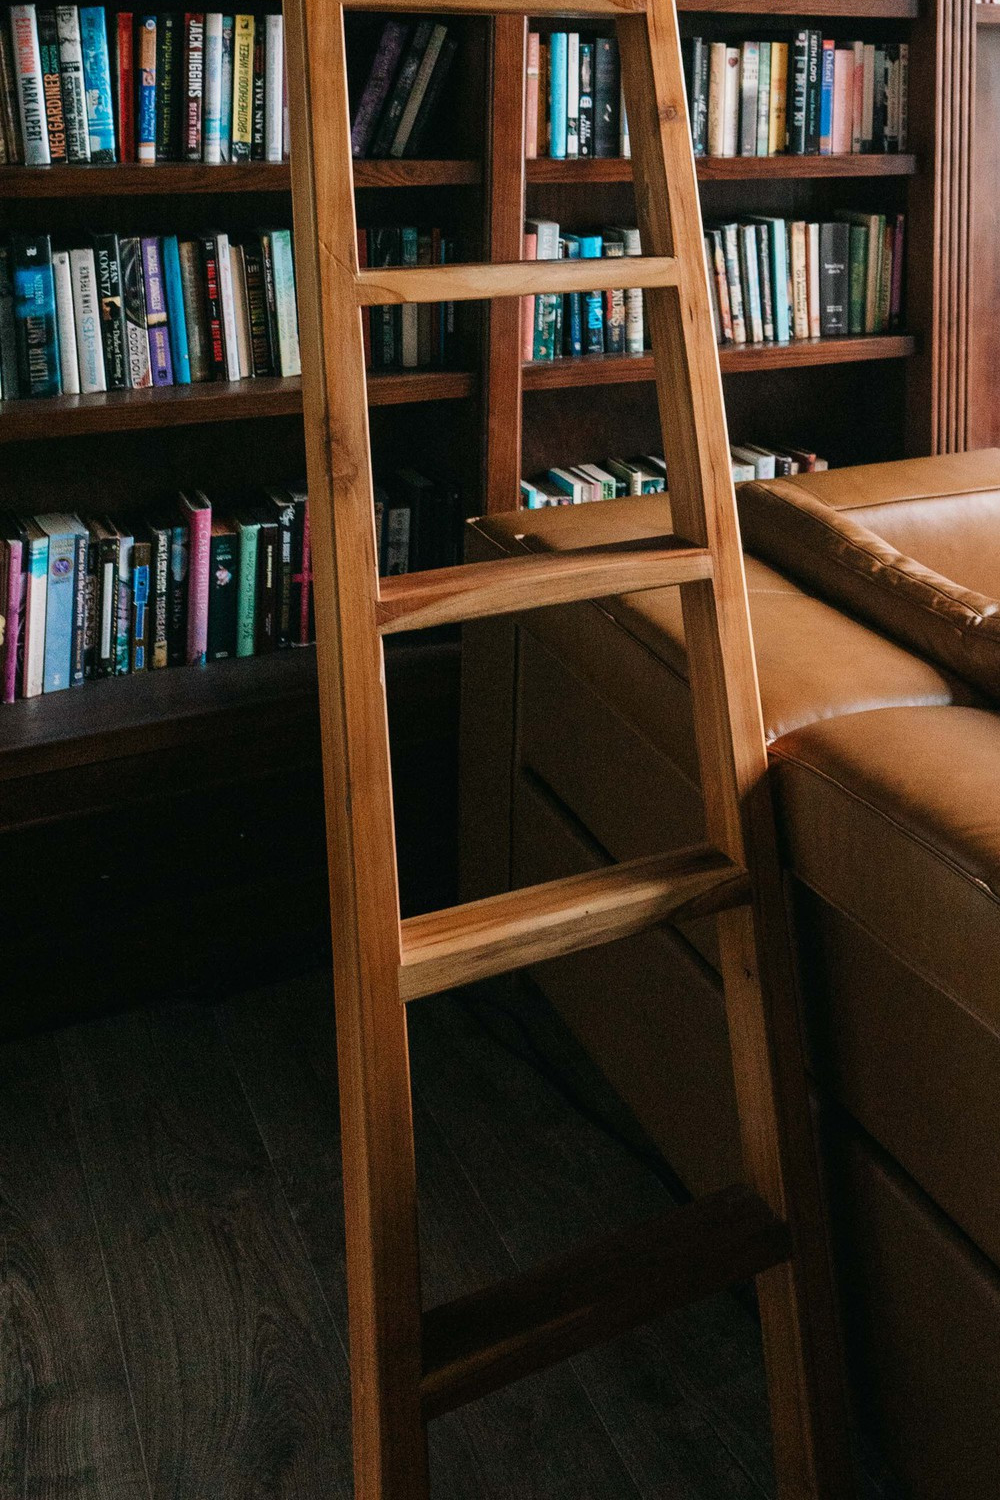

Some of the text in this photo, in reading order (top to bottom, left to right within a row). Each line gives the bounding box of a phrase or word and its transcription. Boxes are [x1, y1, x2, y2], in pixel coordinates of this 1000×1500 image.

[162, 30, 172, 71] window
[188, 19, 203, 98] JACK HIGGINS
[239, 42, 249, 69] WHEEL
[825, 50, 834, 82] Oxford
[15, 17, 42, 142] EXTINCTION MARK ALPERT
[62, 76, 74, 114] MADNESS
[255, 78, 264, 107] TALK
[44, 73, 66, 158] MEG GARDINER
[237, 76, 248, 134] BROTHERHOOD
[162, 107, 171, 144] woman
[188, 102, 198, 149] DEATH TRADE
[255, 110, 264, 144] PLAIN
[68, 132, 78, 158] AFTER
[98, 249, 111, 297] KOONTZ
[109, 260, 118, 283] DEAN
[147, 245, 158, 275] MICHAEL
[35, 274, 44, 305] HORIZON
[79, 266, 91, 292] FRENCH
[206, 259, 217, 299] FINAL GIRLS
[211, 319, 221, 339] RILEY
[129, 328, 141, 387] RODDY DOYLE
[196, 530, 208, 616] CARLY PHILLIPS
